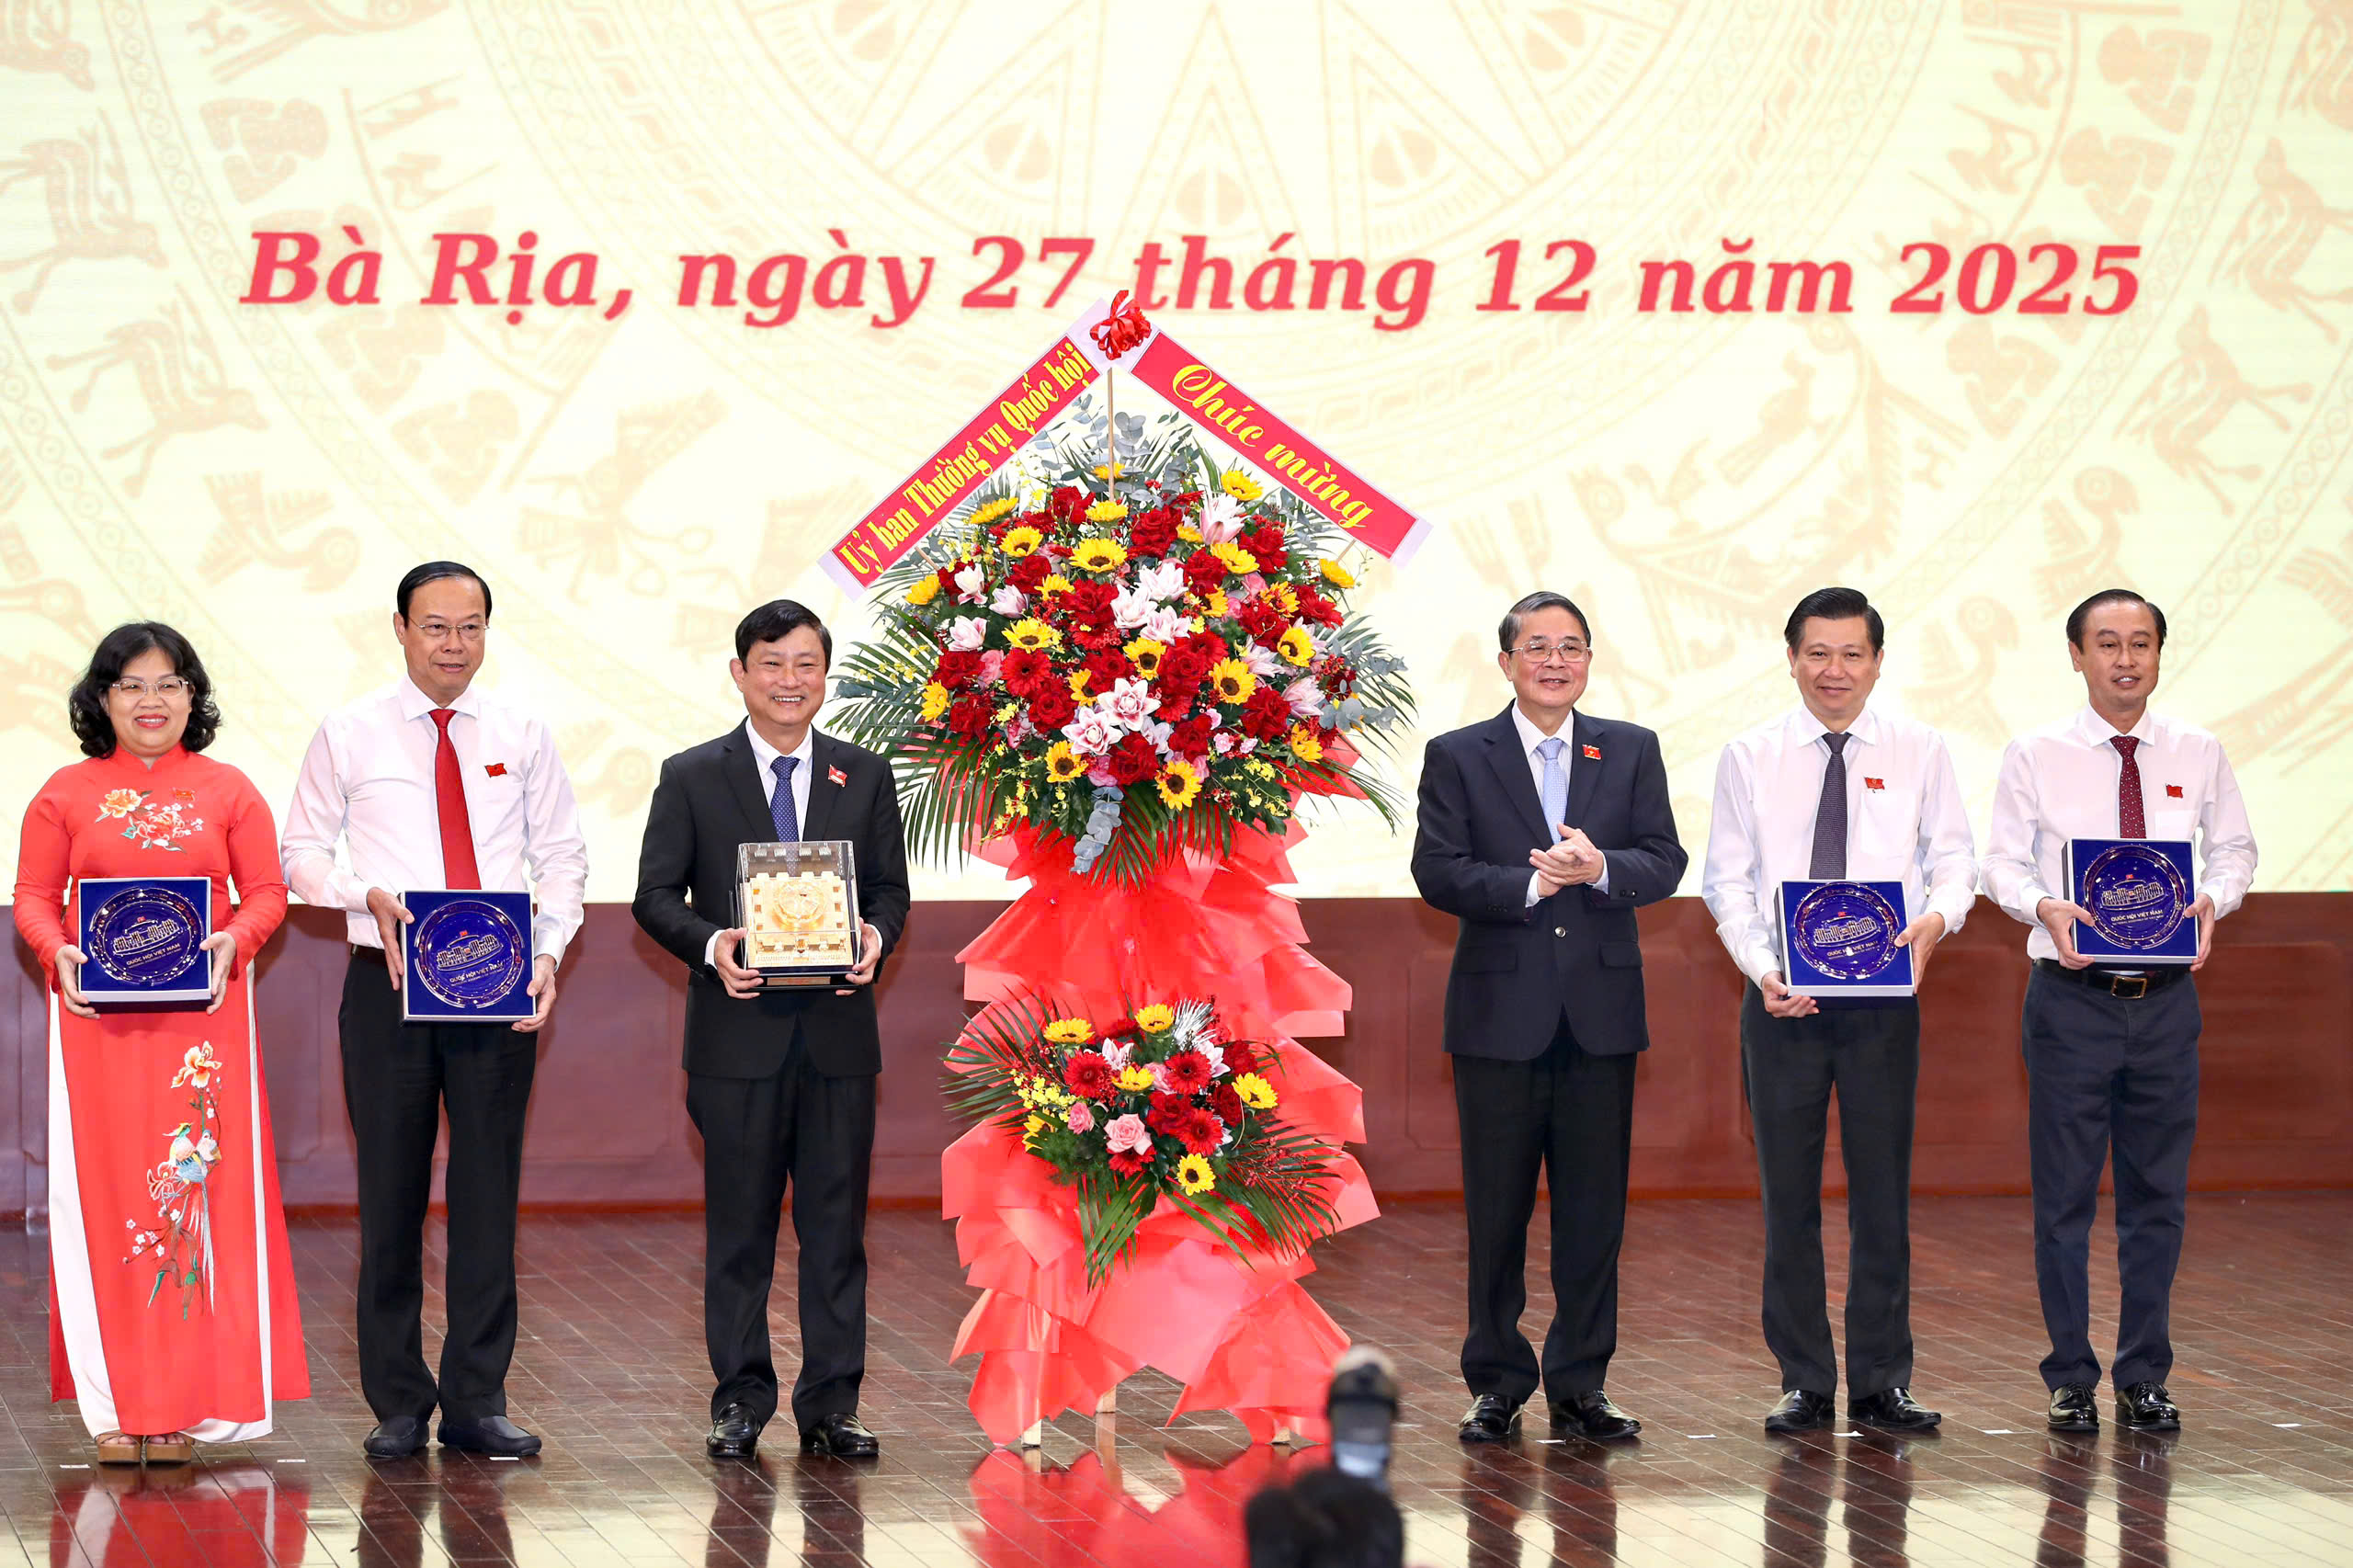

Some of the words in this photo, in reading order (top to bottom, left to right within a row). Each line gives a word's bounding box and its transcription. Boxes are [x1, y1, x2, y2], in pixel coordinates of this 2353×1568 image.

[238, 224, 383, 306] Bà
[419, 230, 634, 325] Rịa,
[676, 228, 936, 329] ngày
[960, 235, 1096, 309] 27
[1132, 232, 1437, 333] tháng
[1474, 238, 1597, 312] 12
[1637, 237, 1854, 314] năm
[1889, 242, 2142, 316] 2025
[867, 506, 920, 551] ban
[903, 441, 993, 517] Thường
[977, 422, 1017, 454] vụ
[999, 372, 1059, 436] Quốc
[1043, 342, 1092, 392] hội
[1172, 364, 1264, 448] Chúc
[1265, 443, 1374, 528] mừng
